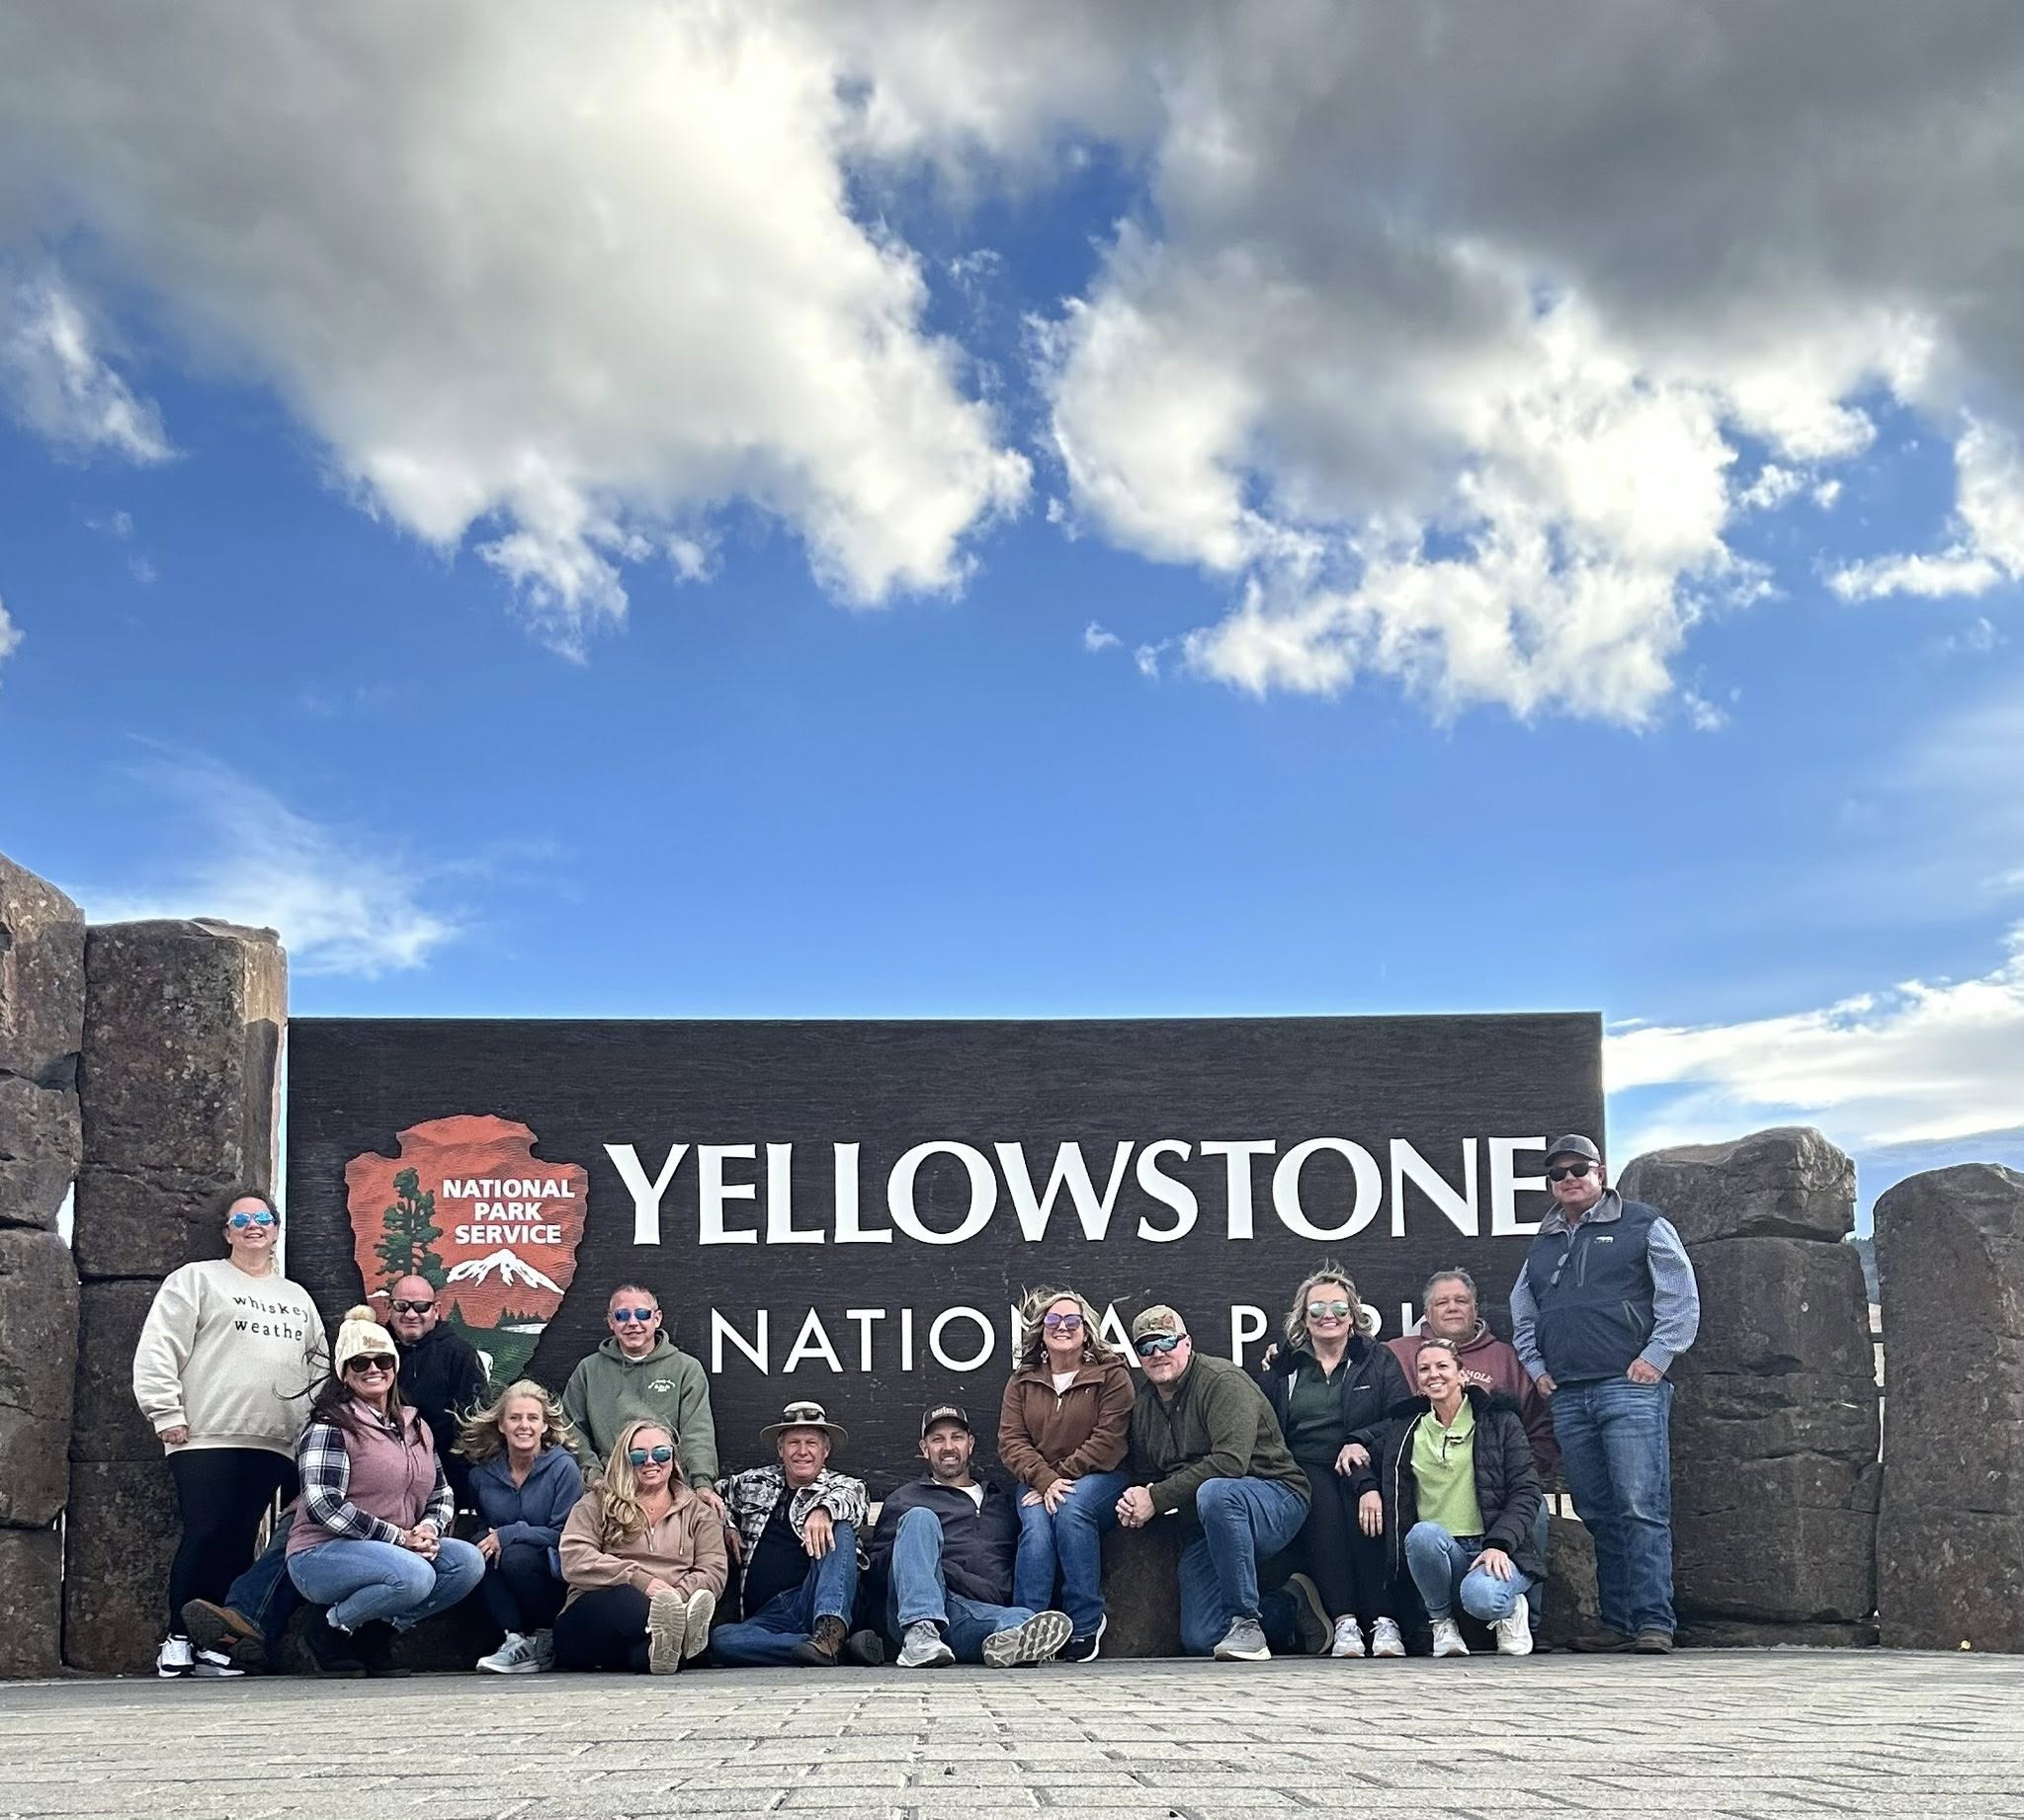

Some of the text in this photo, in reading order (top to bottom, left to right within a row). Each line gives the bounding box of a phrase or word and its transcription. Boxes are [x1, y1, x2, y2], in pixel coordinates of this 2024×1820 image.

[442, 1179, 575, 1199] NATIONAL
[602, 1135, 1548, 1246] YELLOWSTONE
[474, 1201, 543, 1221] PARK
[455, 1224, 562, 1245] SERVICE
[711, 1302, 1143, 1376] NATIOA
